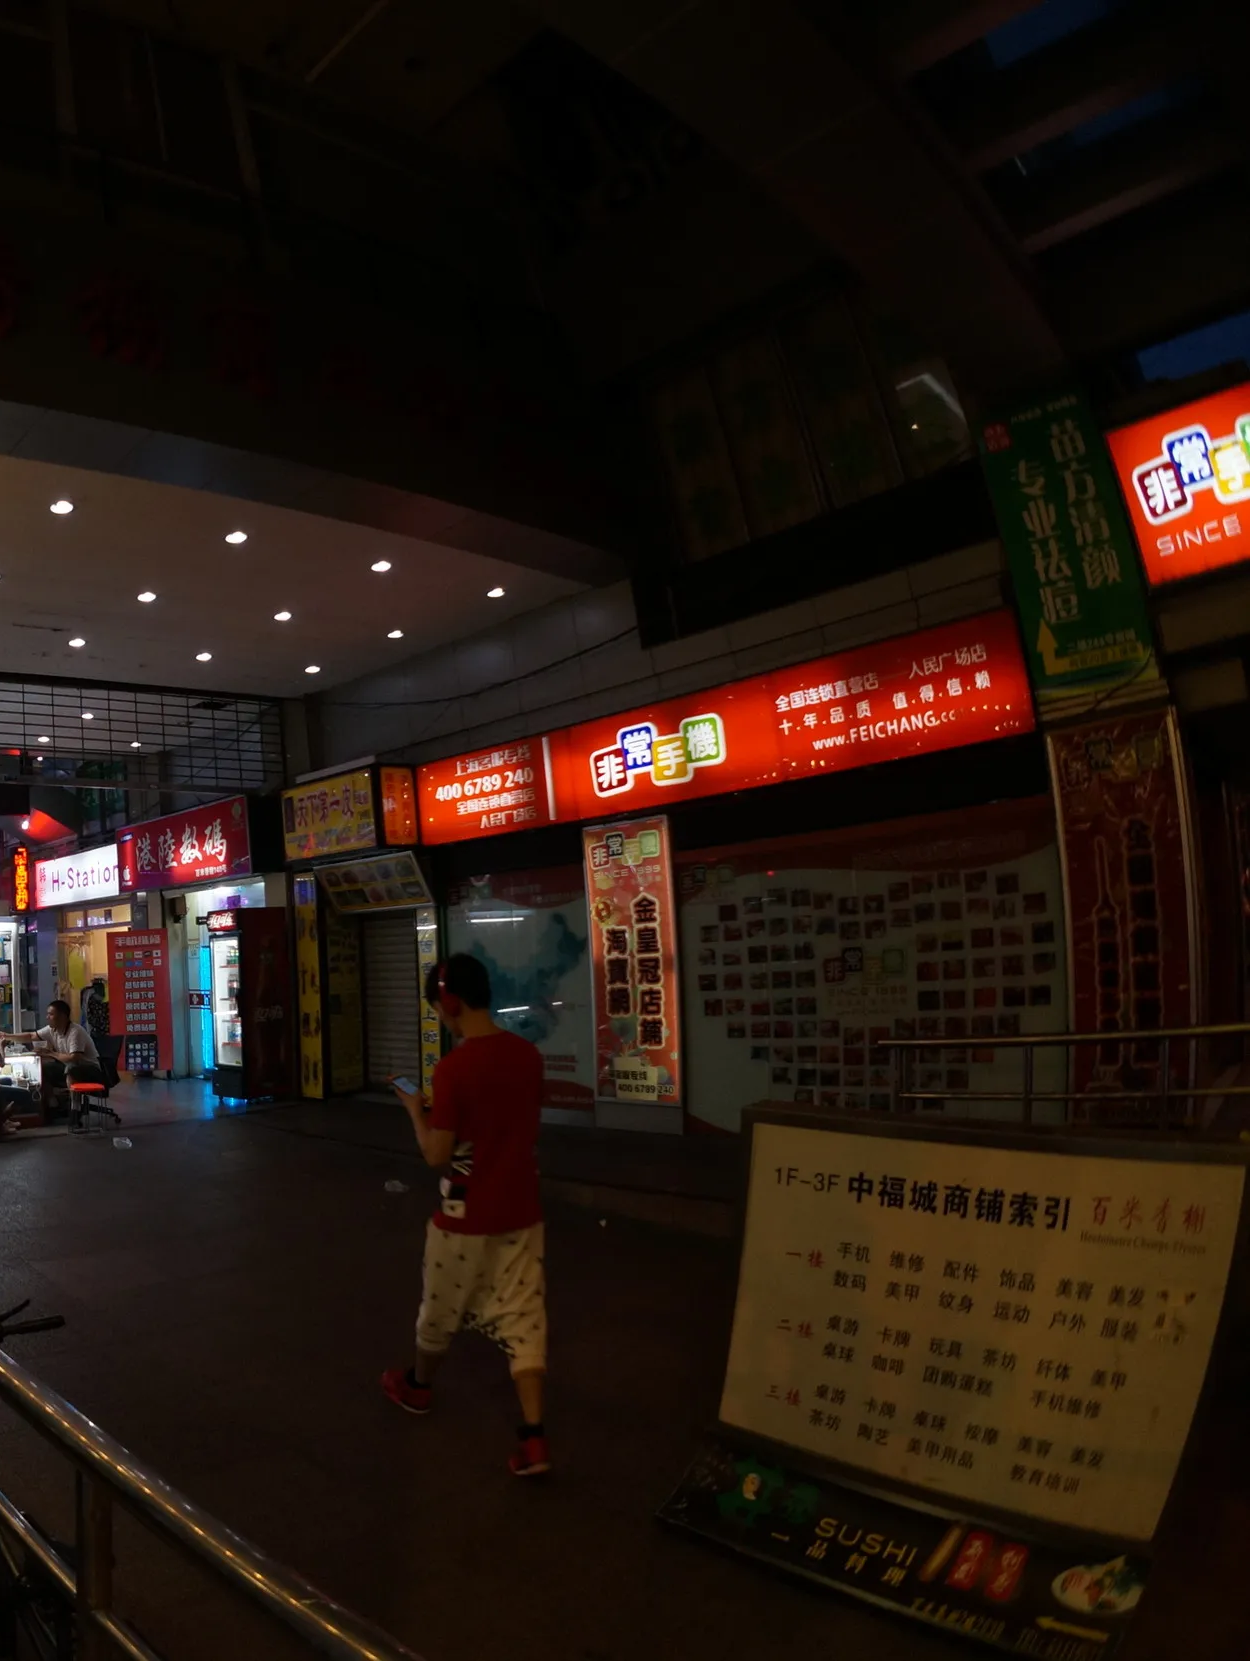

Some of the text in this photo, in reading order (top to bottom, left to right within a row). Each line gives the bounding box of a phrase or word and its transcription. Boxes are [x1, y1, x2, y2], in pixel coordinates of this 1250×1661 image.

[1156, 513, 1242, 557] SINCE
[774, 643, 987, 713] 全国连锁直营店 人民广场店
[435, 767, 534, 802] 400 6789 240
[593, 714, 725, 794] 非常手機
[51, 861, 119, 893] H-Station
[775, 1167, 1071, 1231] 1F-3F 中福城商铺索引
[833, 1270, 1138, 1343] 数码 美甲 纹身 运动 户外 服装
[836, 1241, 871, 1264] 手机
[889, 1250, 925, 1273] 维修
[943, 1259, 979, 1283] 配件
[1000, 1268, 1035, 1292] 饰品
[1056, 1278, 1094, 1302] 美容
[1109, 1285, 1145, 1306] 美发
[822, 1341, 855, 1363] 桌球
[871, 1353, 905, 1376] 咖啡
[1031, 1389, 1102, 1419] 手机维修
[826, 1314, 859, 1337] 桌游
[876, 1326, 911, 1348] 卡牌
[928, 1337, 963, 1360] 玩具
[983, 1348, 1017, 1372] 茶坊
[1035, 1358, 1071, 1383] 纤体
[1091, 1368, 1128, 1391] 美甲
[808, 1408, 842, 1432] 茶坊
[905, 1437, 974, 1470] 美甲用品
[1010, 1463, 1081, 1496] 教育培训
[814, 1383, 847, 1406] 桌游
[864, 1396, 897, 1420] 卡牌
[913, 1410, 948, 1433] 桌球
[1017, 1435, 1054, 1459] 美容
[1069, 1446, 1105, 1472] 美发
[770, 1530, 909, 1588] 一品料理
[814, 1516, 920, 1568] SUSHI
